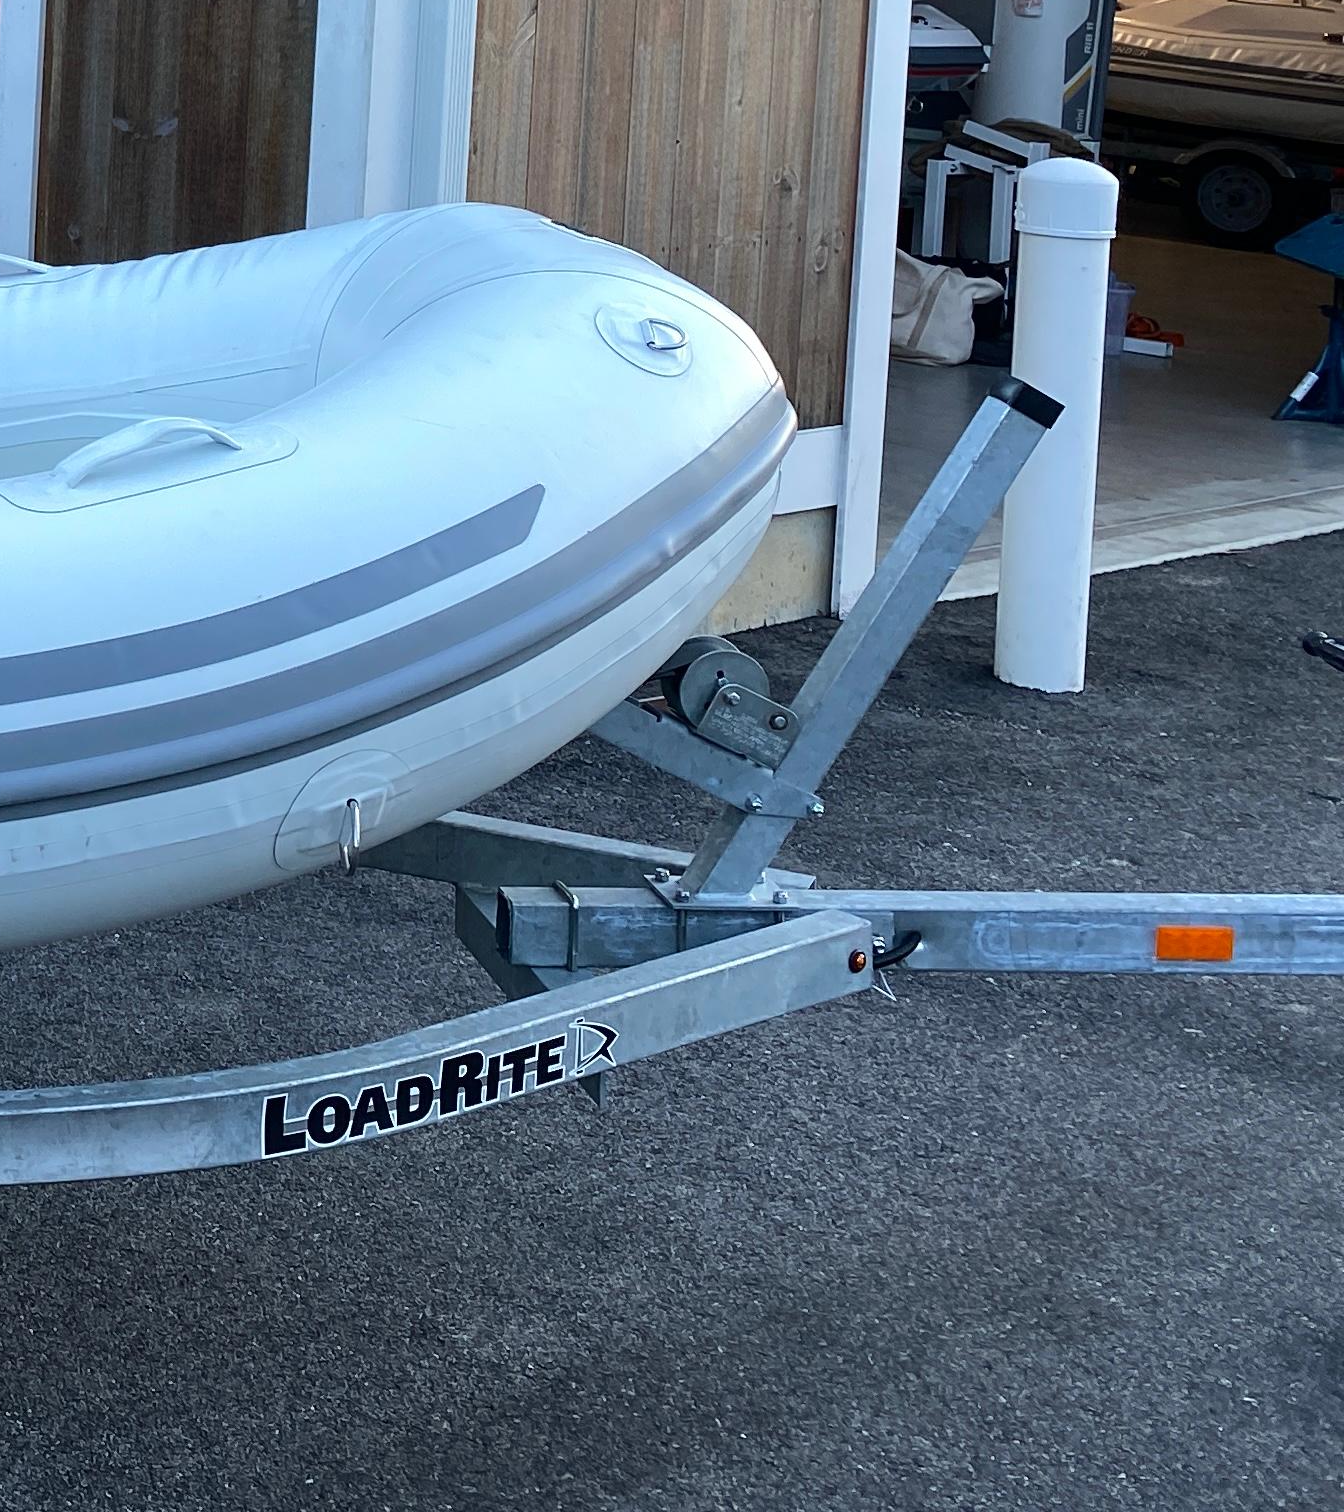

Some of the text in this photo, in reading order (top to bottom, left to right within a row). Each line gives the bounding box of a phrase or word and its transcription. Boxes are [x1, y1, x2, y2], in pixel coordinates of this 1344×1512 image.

[1084, 33, 1094, 55] RIB
[1076, 108, 1085, 130] mini
[262, 1034, 567, 1159] LOADRITE
